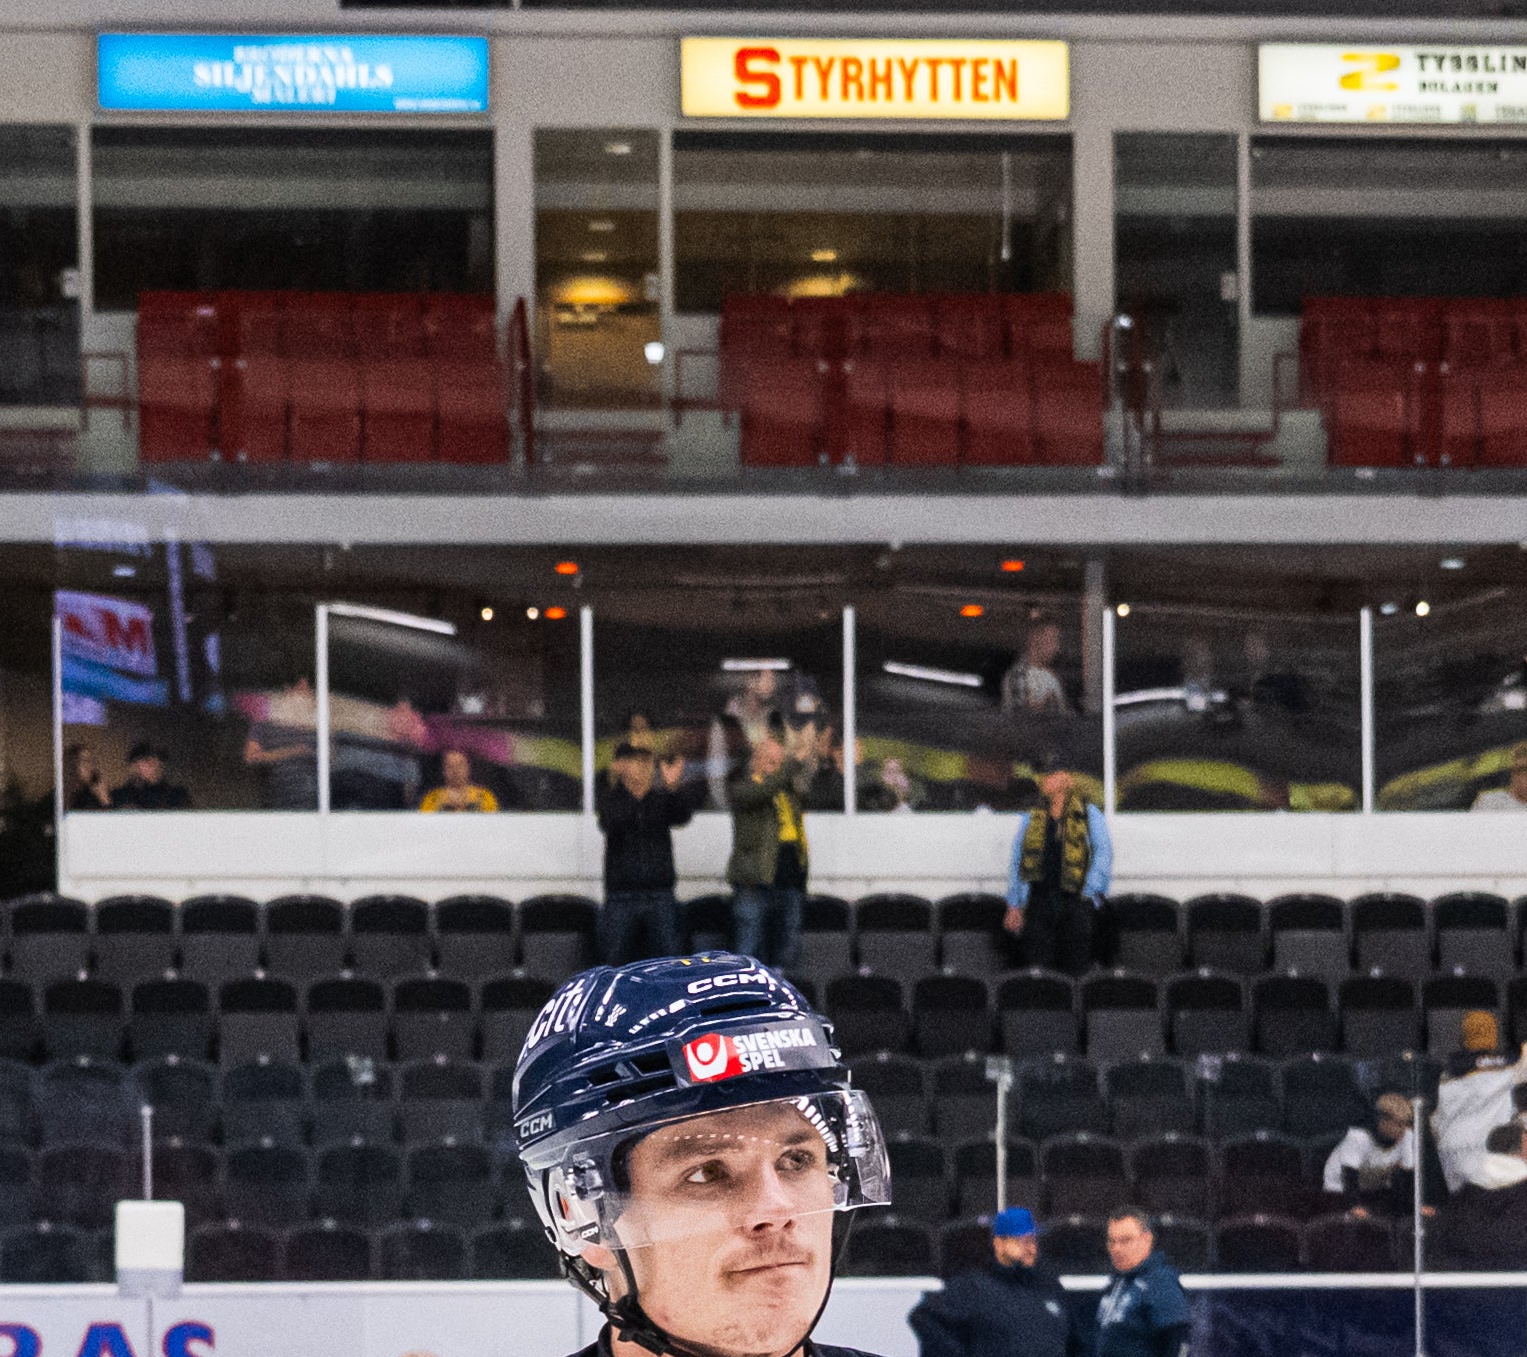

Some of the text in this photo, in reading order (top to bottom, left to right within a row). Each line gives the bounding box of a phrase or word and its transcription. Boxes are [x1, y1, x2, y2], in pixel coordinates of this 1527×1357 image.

[734, 46, 1020, 110] STYRHYTTEN
[687, 971, 773, 996] CCM
[732, 1027, 817, 1056] SVENSKA
[740, 1050, 786, 1073] SPEL
[519, 1110, 554, 1138] CCM
